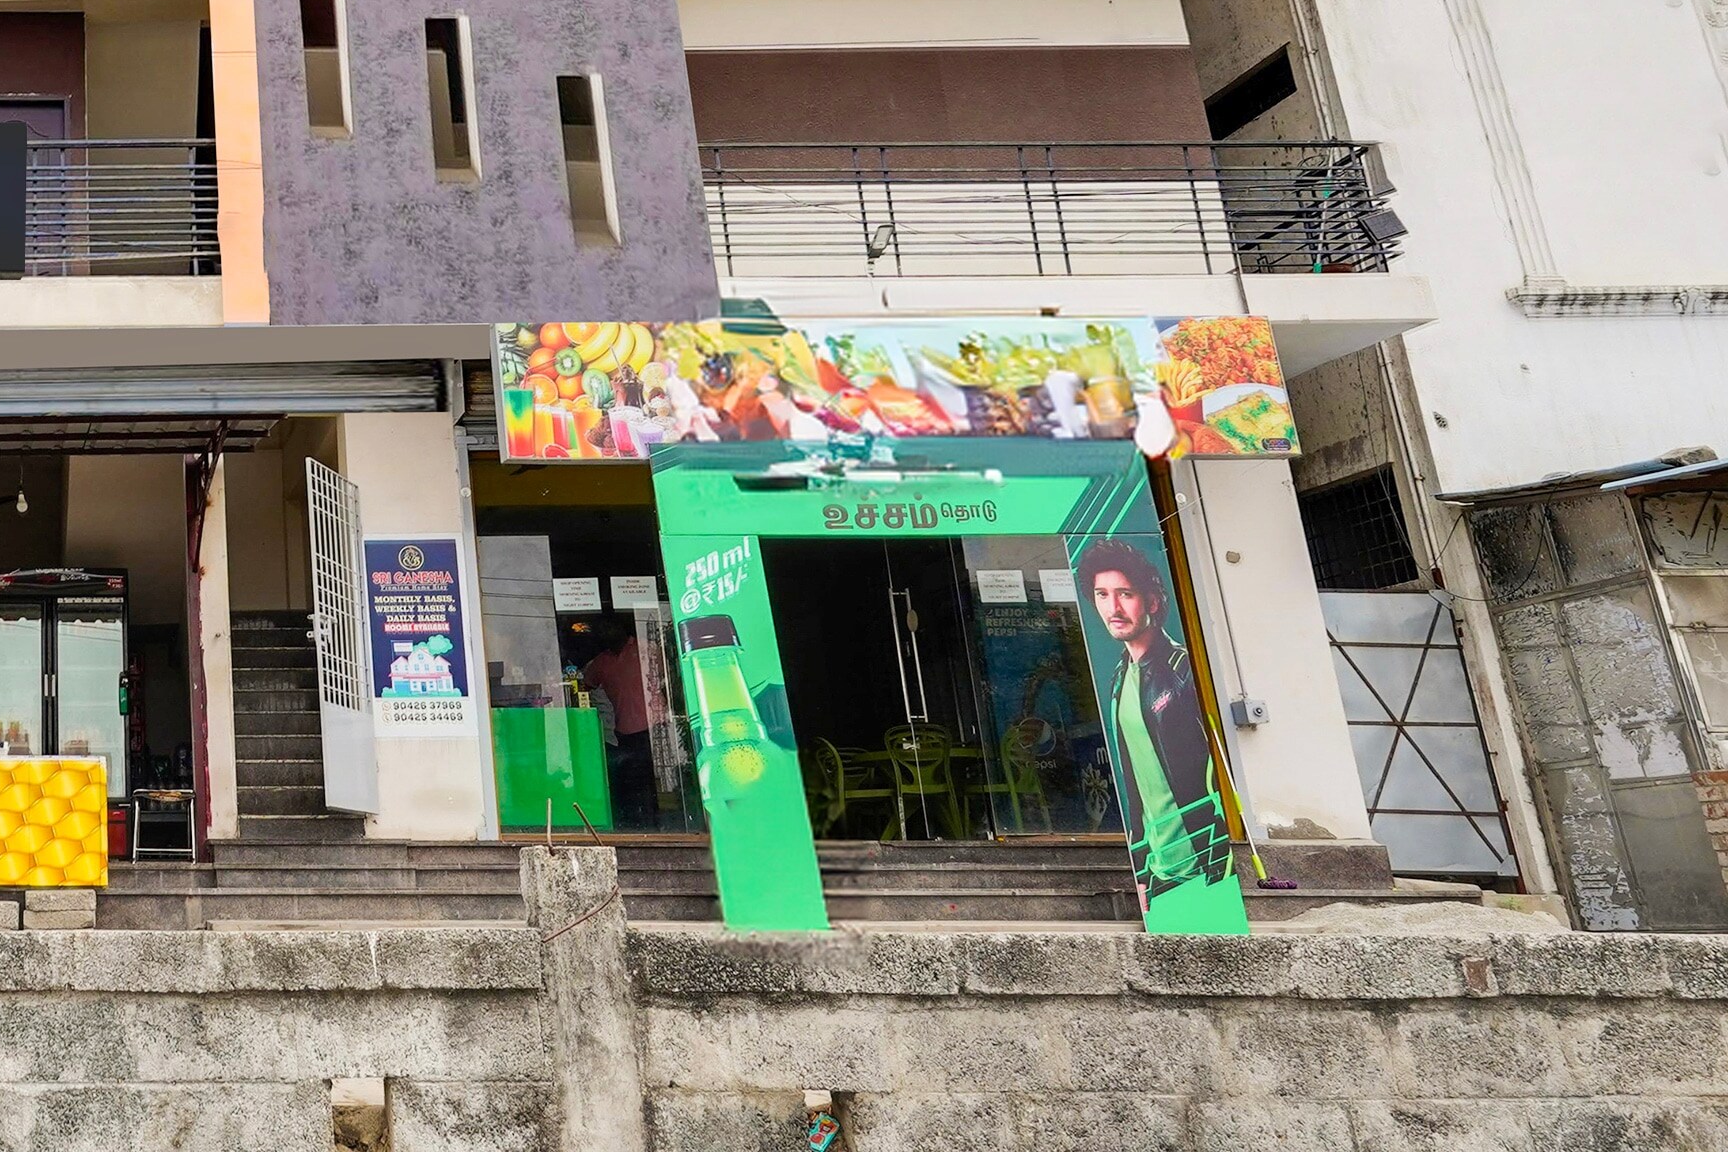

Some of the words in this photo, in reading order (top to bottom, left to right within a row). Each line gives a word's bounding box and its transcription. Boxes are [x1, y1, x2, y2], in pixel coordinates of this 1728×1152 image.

[685, 550, 720, 588] 250
[722, 535, 751, 570] ml
[371, 571, 392, 585] SRI
[393, 570, 454, 585] GANESHA
[374, 595, 422, 603] MONTHLY
[374, 605, 416, 613] WEEKLY
[995, 608, 1029, 617] ENJOY
[417, 614, 447, 622] BASIS
[987, 627, 1017, 636] PEPSI
[393, 701, 427, 710] 90426
[393, 713, 428, 722] 90425
[430, 712, 463, 721] 34469
